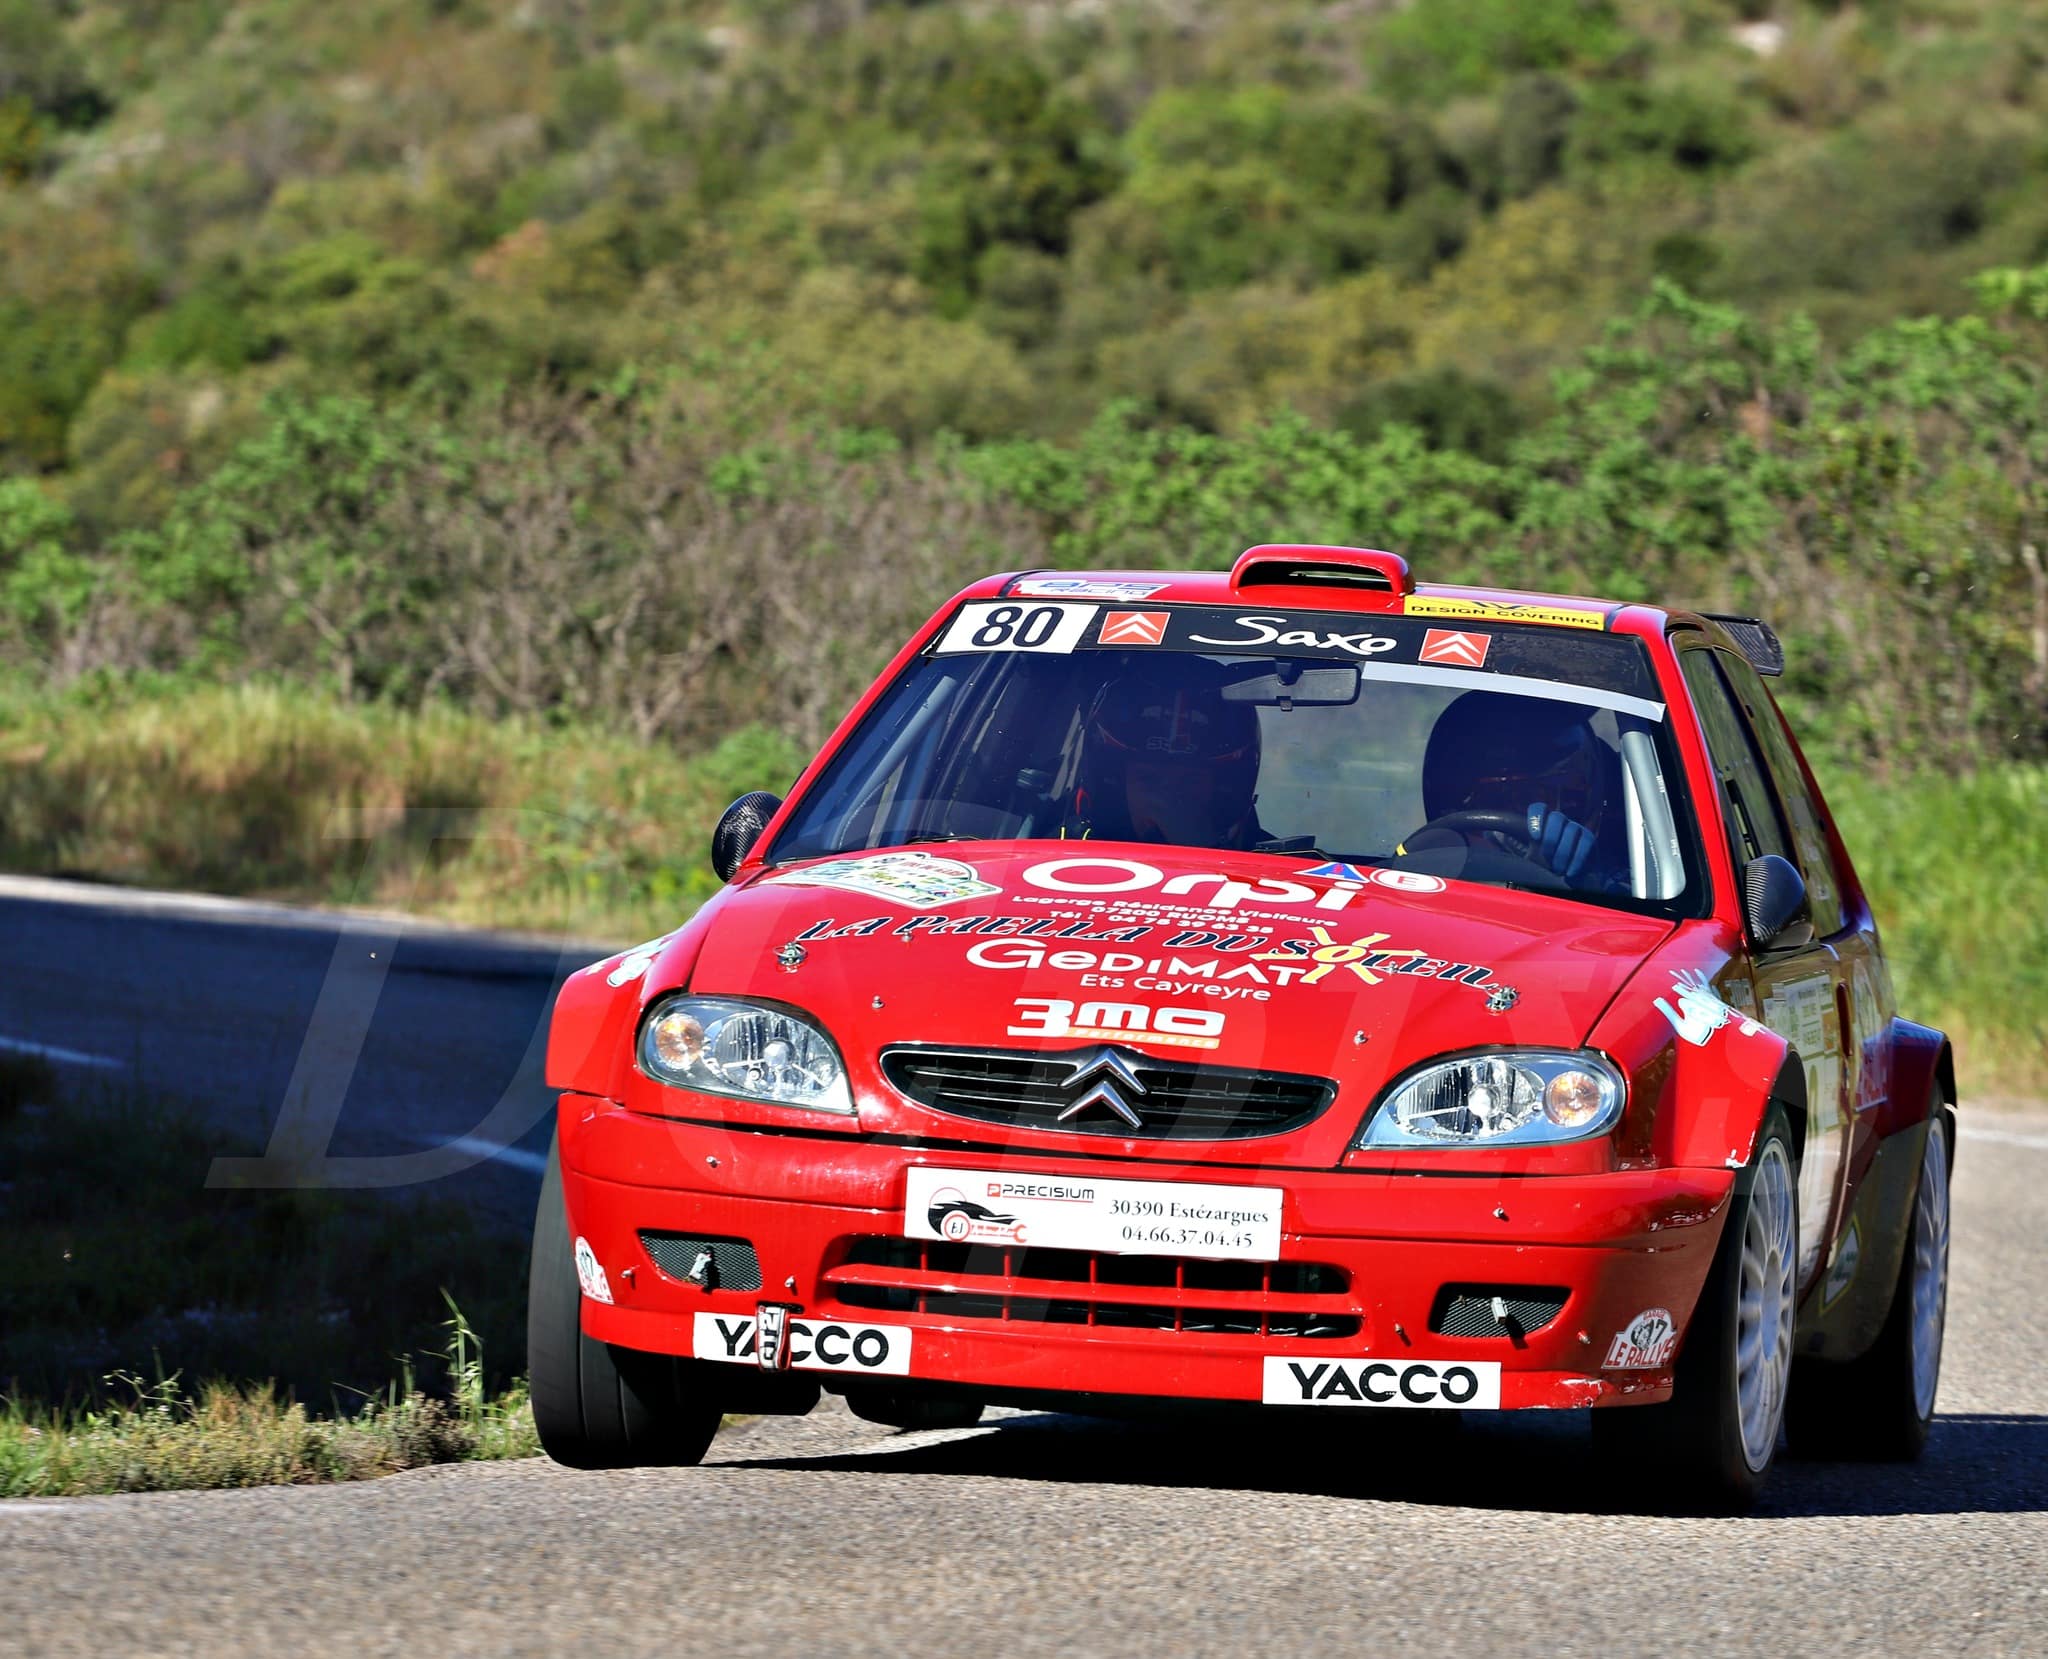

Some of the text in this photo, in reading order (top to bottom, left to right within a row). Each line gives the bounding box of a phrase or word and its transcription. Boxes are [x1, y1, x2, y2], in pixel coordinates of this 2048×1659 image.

[971, 606, 1065, 647] 80
[1411, 605, 1600, 625] DESIGN COVERING
[1189, 616, 1398, 656] Saxo
[1022, 858, 1364, 911] Orpi
[1090, 906, 1251, 924] 07200 RUOMS
[1108, 914, 1137, 923] 04
[1211, 921, 1239, 931] 63
[796, 916, 893, 941] LA
[892, 915, 1154, 943] PAELLA
[1162, 930, 1274, 952] DU
[1080, 973, 1272, 1000] Ets Cayreyre
[1002, 1184, 1095, 1200] PRECISIUM
[1109, 1199, 1269, 1227] 30390 Estézargues
[1122, 1225, 1253, 1248] 04.66.37.04.45
[1605, 1336, 1628, 1366] LE
[1287, 1363, 1479, 1404] YACCO
